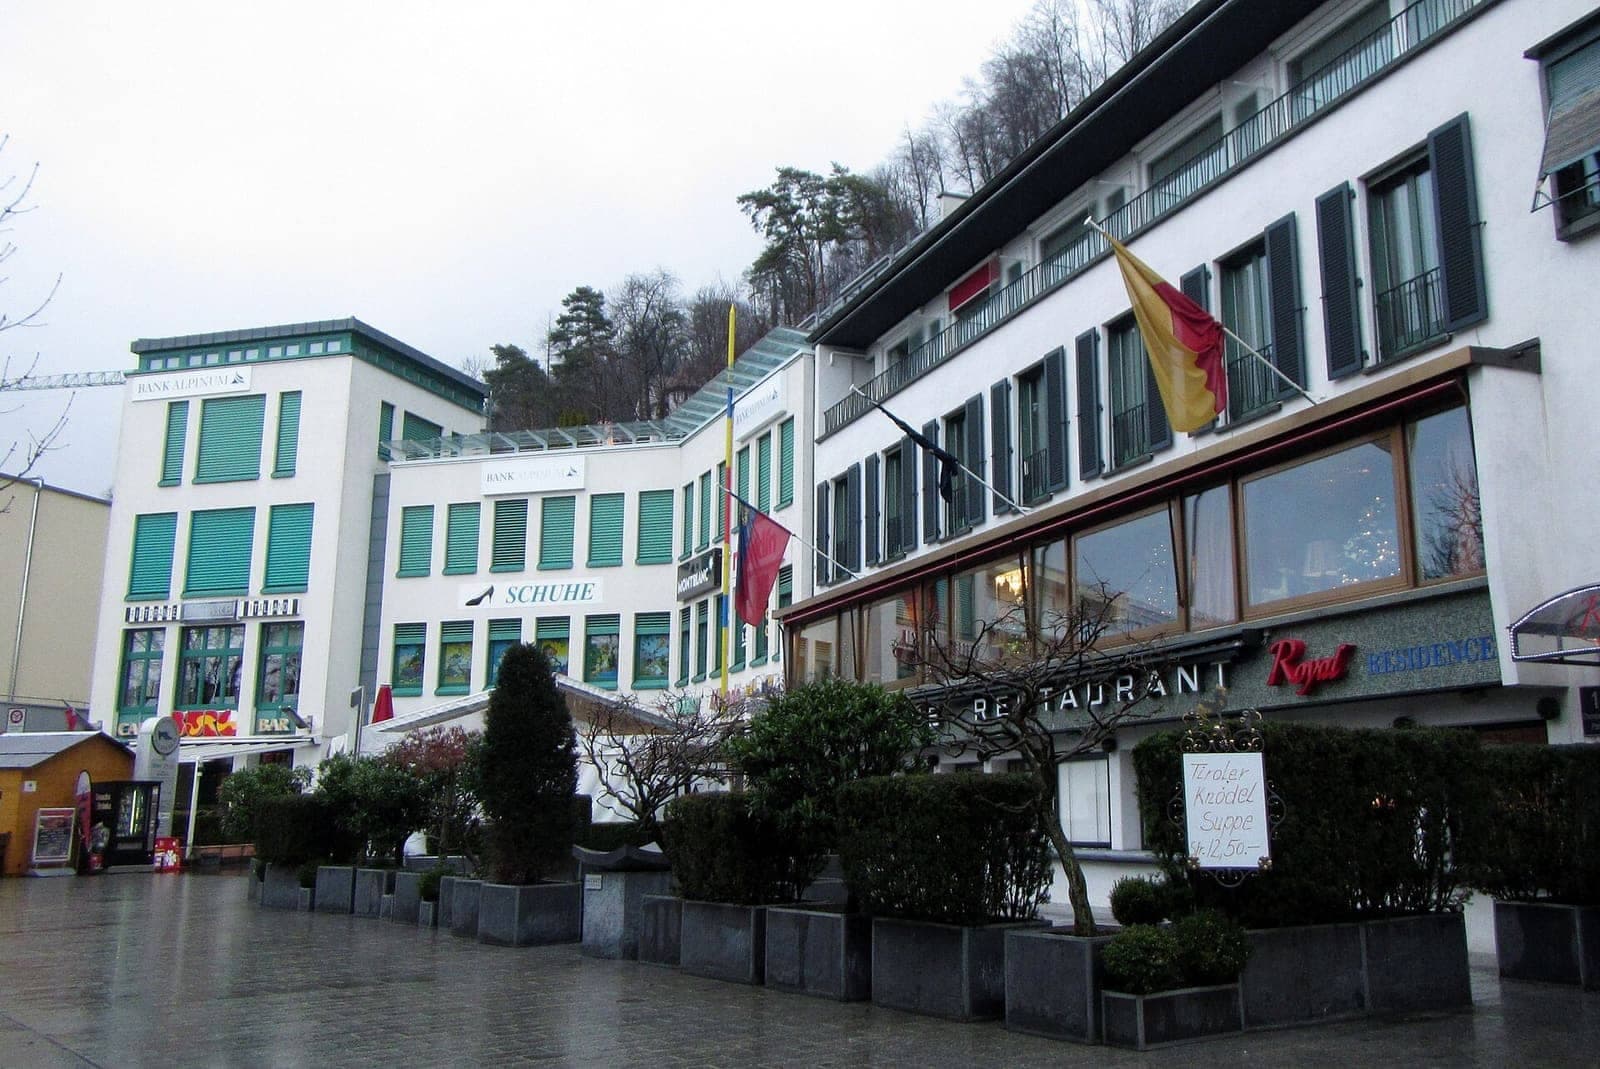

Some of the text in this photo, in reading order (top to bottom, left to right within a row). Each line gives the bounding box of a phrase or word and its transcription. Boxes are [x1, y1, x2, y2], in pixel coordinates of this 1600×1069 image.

[138, 376, 228, 393] BANK ALPINUM
[486, 471, 514, 483] BANK
[505, 582, 595, 604] SCHUHE
[1266, 635, 1499, 696] Royal RESIDENCE
[973, 662, 1225, 722] RETAURANT
[258, 718, 290, 732] BAR
[1191, 760, 1250, 781] Tiroler
[1200, 811, 1254, 838] Suppe
